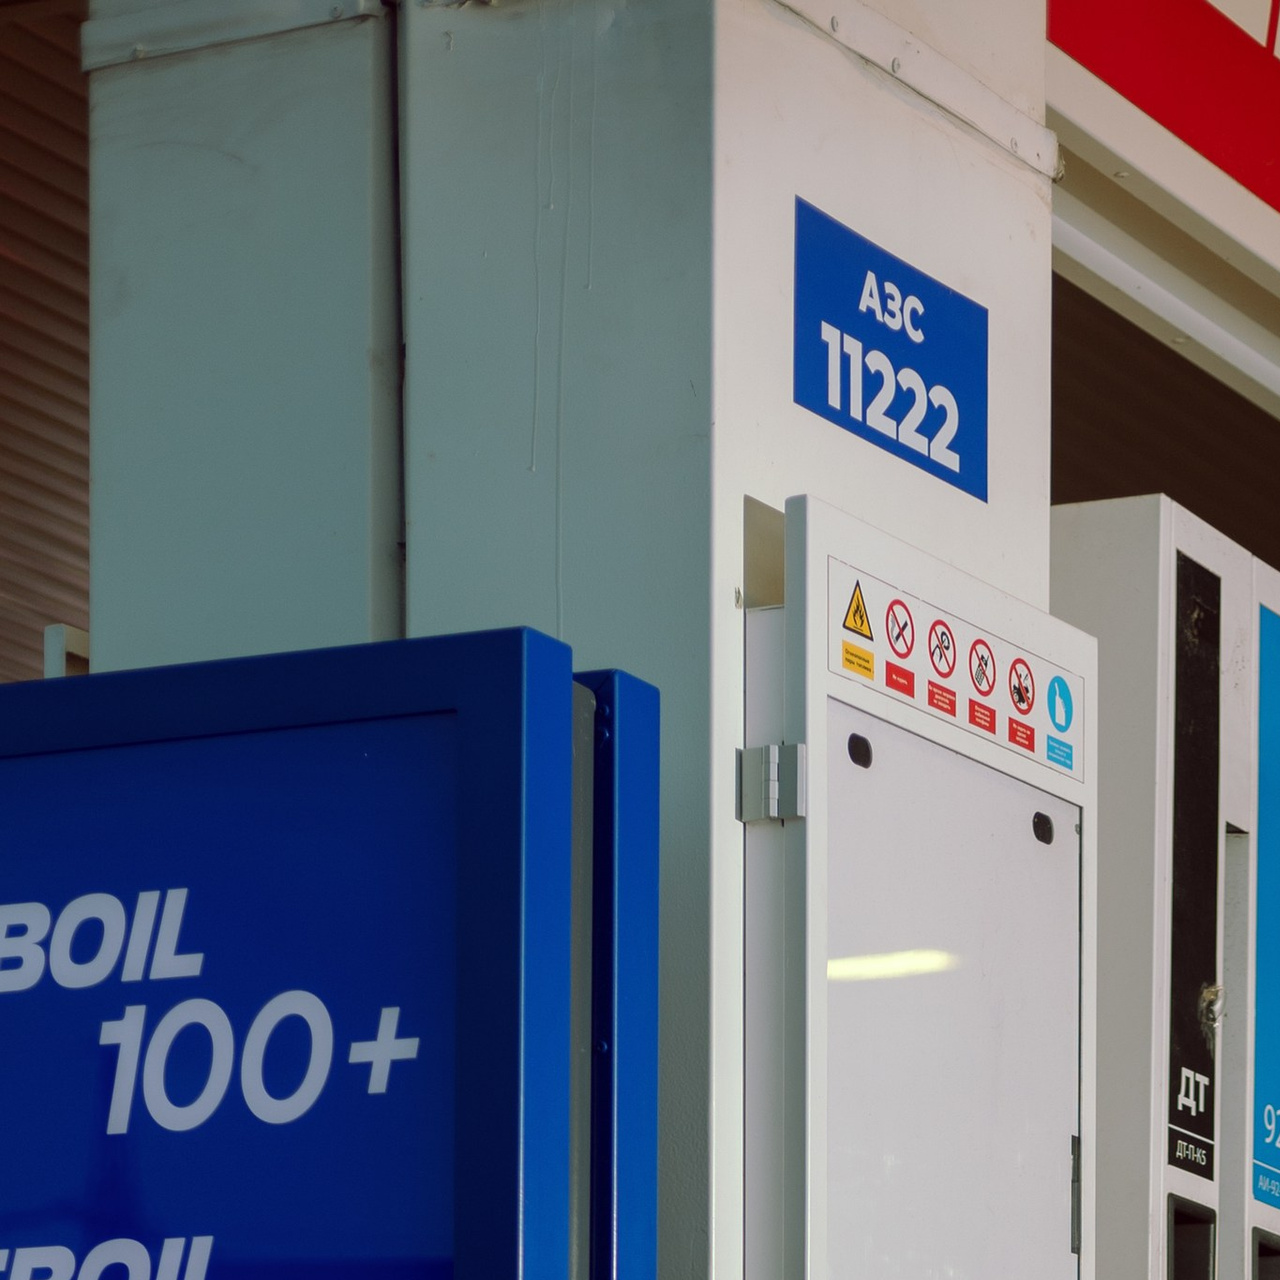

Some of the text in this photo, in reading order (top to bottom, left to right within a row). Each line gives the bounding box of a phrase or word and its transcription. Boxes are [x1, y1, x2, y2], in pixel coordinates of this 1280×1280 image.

[859, 270, 925, 344] АЗС
[821, 321, 960, 472] 11222
[99, 989, 420, 1135] 100+
[1177, 1066, 1210, 1117] ДТ
